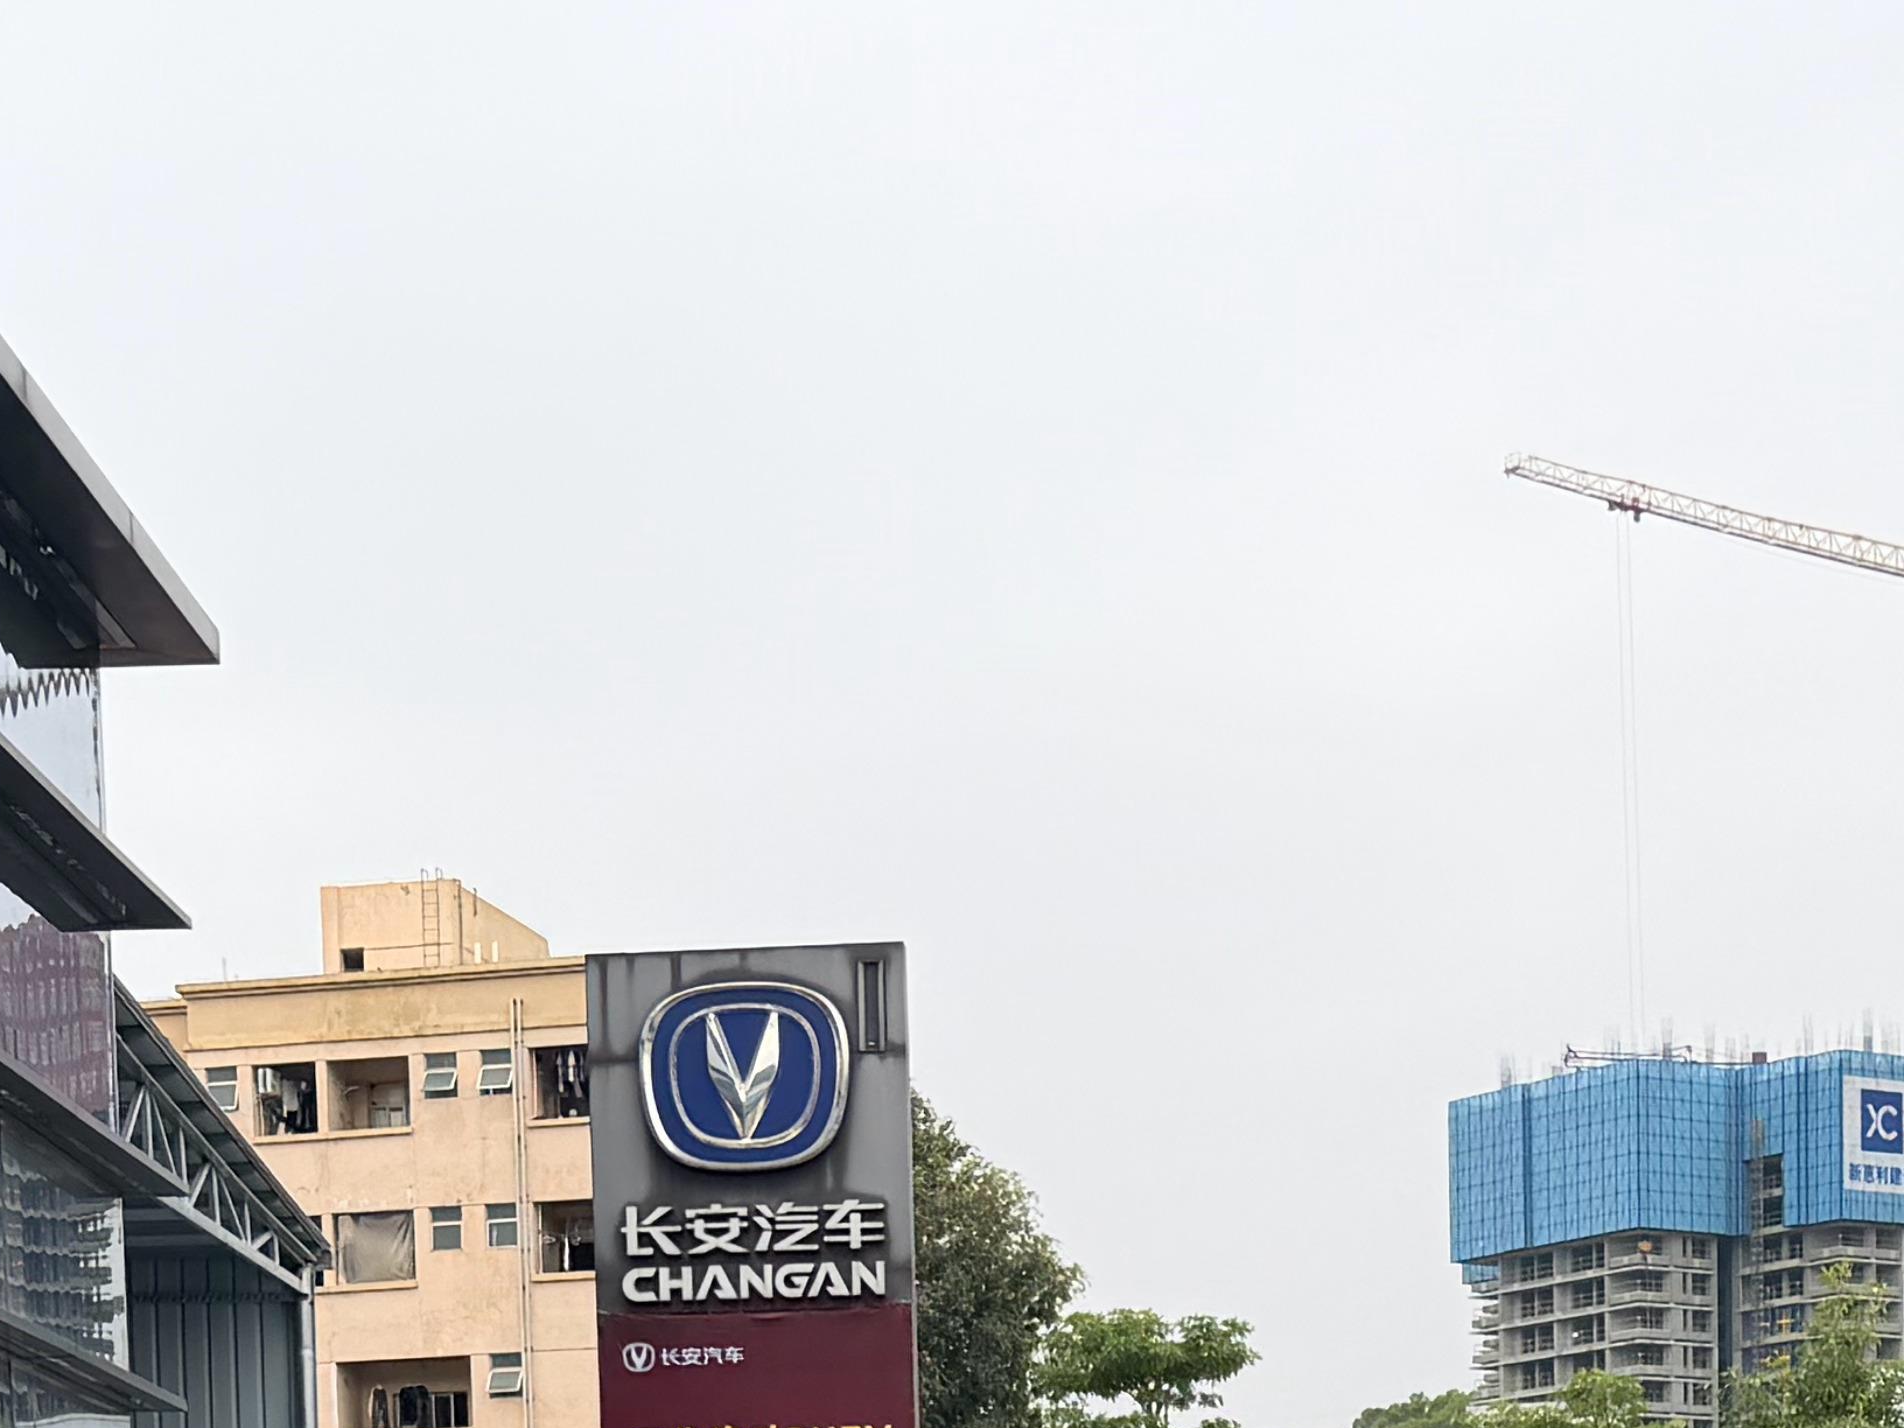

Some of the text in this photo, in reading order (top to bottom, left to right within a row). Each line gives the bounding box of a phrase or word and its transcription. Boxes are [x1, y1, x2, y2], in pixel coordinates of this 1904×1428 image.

[620, 1199, 886, 1257] 长安汽车
[621, 1259, 887, 1302] CHANGAN
[660, 1346, 746, 1367] 长安汽车
